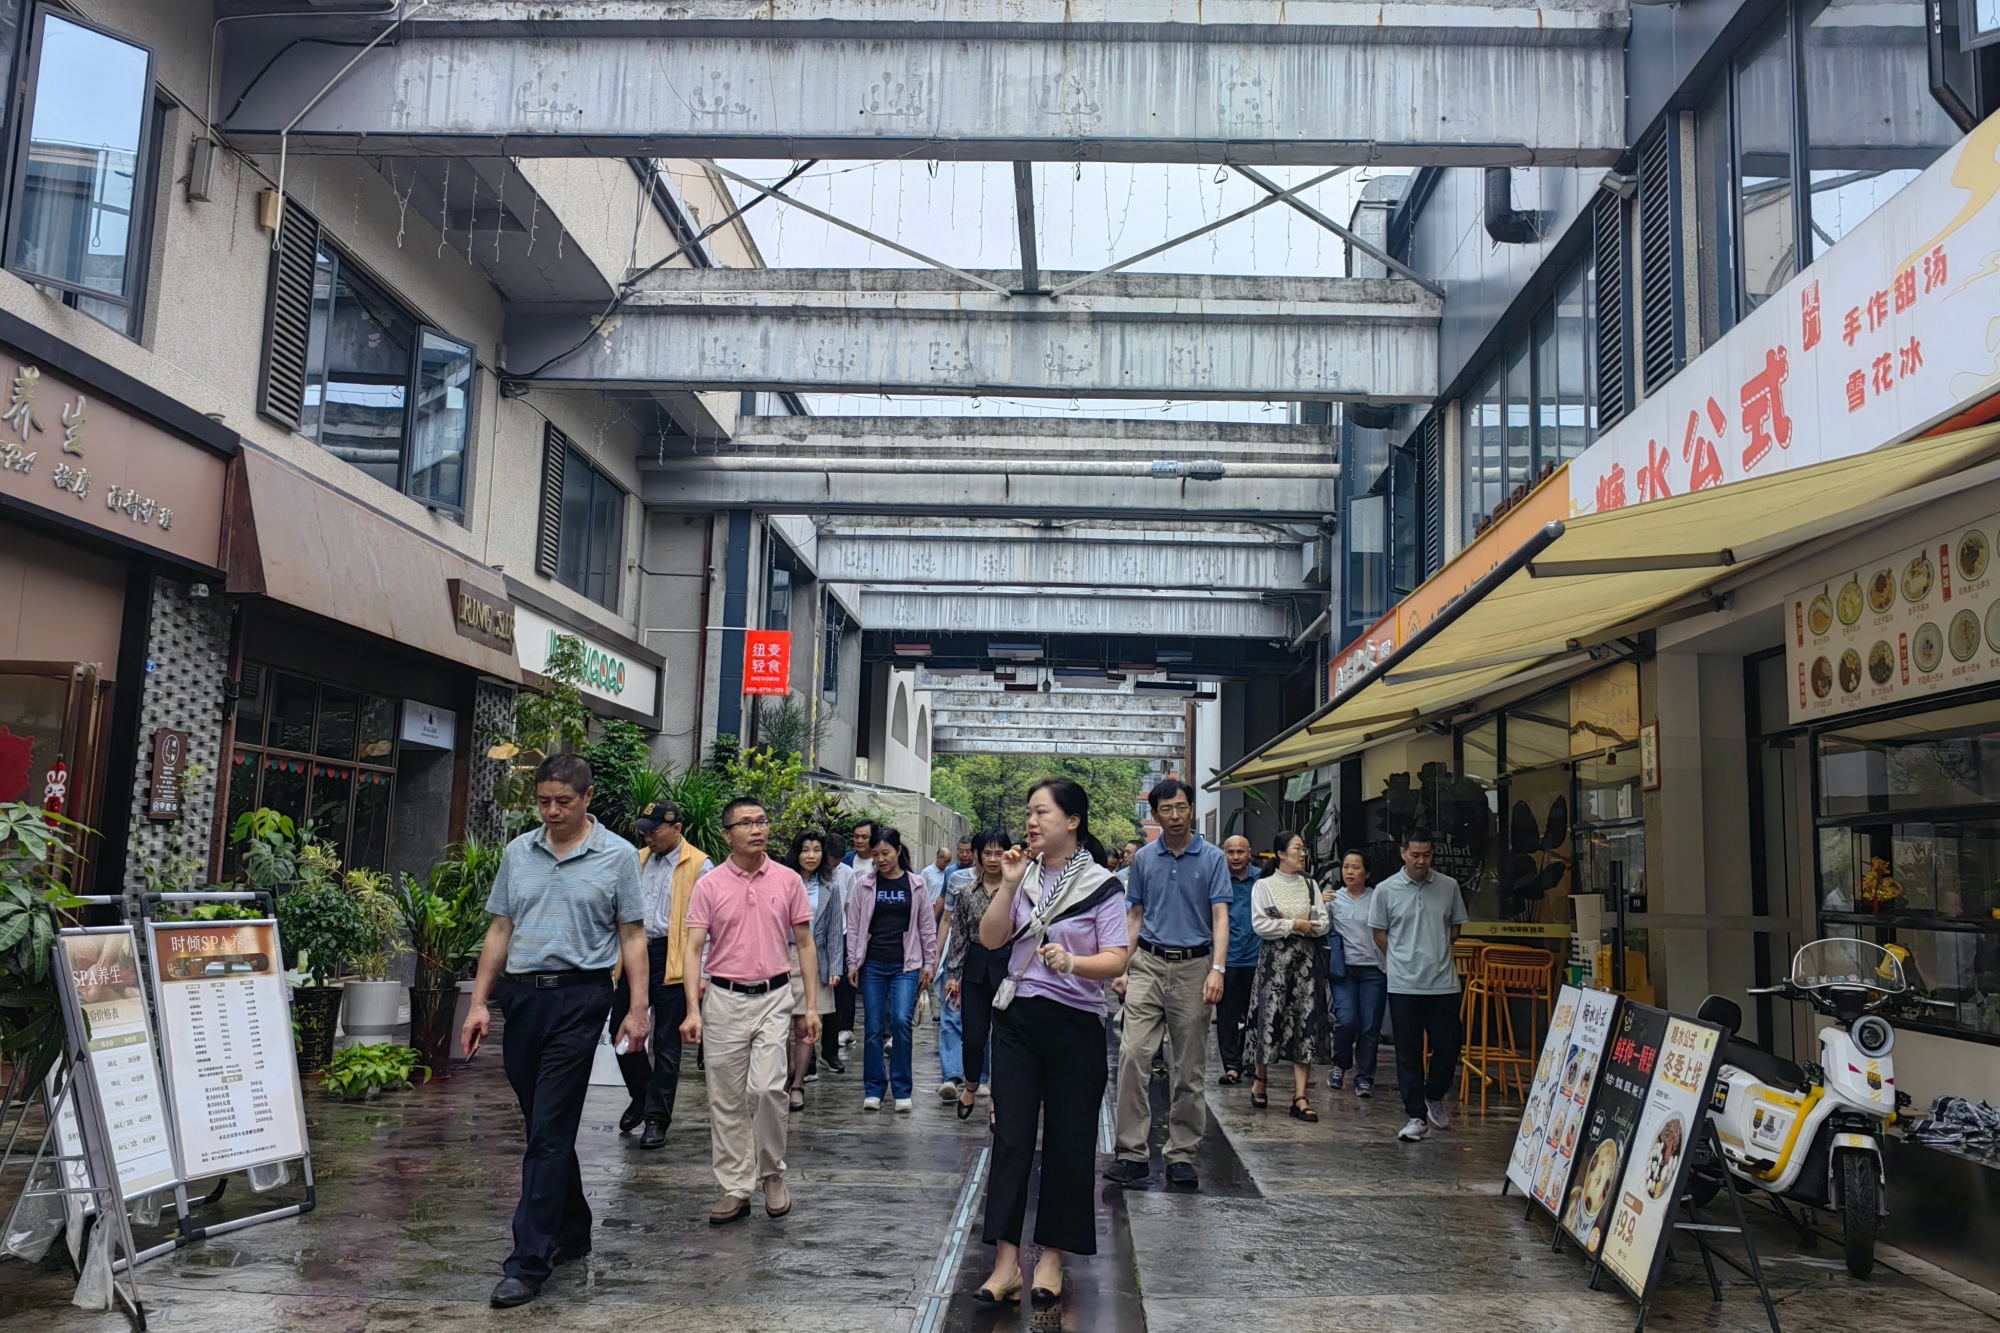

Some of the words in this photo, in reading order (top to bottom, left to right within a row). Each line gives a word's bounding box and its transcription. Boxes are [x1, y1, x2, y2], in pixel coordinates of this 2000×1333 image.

[1802, 279, 1821, 351] 厦门
[1843, 245, 1948, 346] 手作甜汤
[1845, 336, 1924, 413] 雪花冰
[3, 365, 87, 458] 养生
[1596, 345, 1793, 512] 糖水公式
[459, 593, 493, 632] RING
[752, 643, 781, 657] 纽麦
[752, 659, 781, 673] 轻食
[877, 890, 905, 900] ELLE
[1662, 1050, 1703, 1094] 冬季上线
